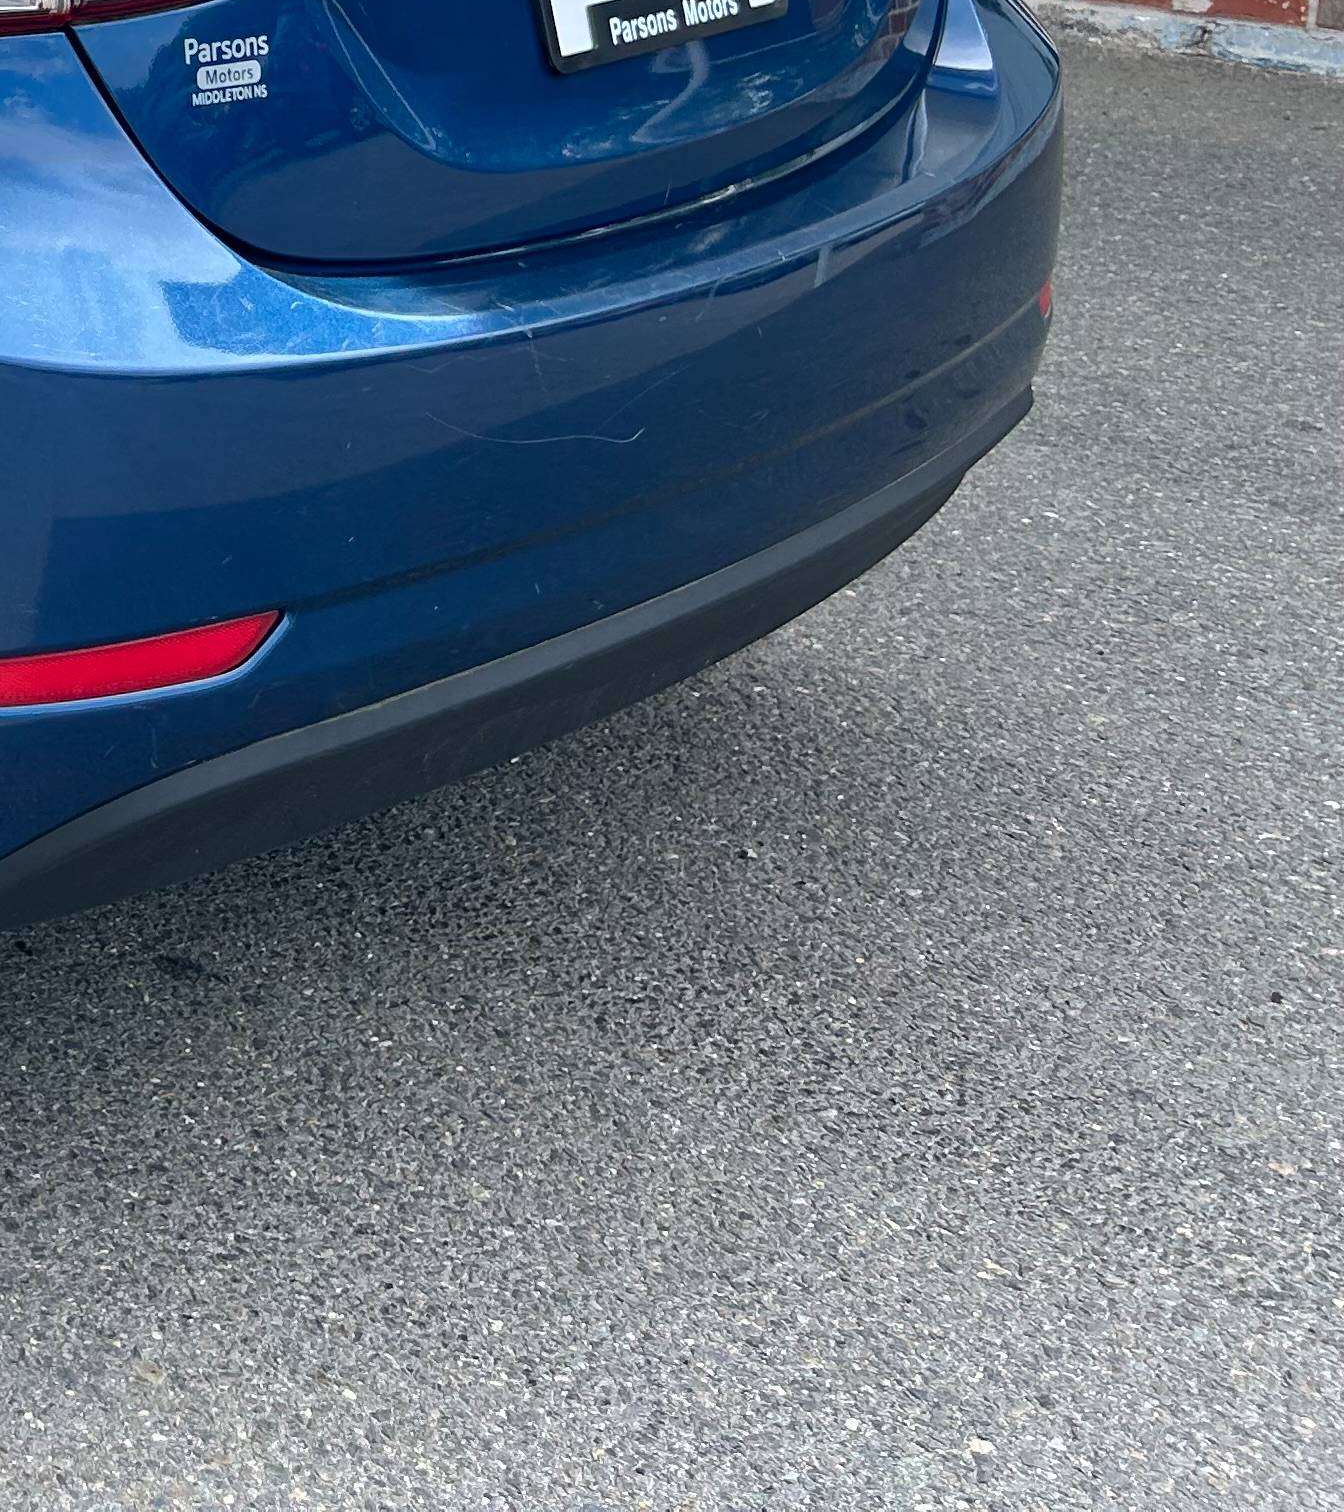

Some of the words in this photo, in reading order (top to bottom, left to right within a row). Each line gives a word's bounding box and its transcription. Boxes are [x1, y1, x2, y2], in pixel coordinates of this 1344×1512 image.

[609, 8, 678, 45] Parsons
[184, 34, 269, 65] Parsons
[205, 67, 253, 86] Motors
[191, 87, 253, 107] MIDDLETON
[253, 83, 268, 99] NS
